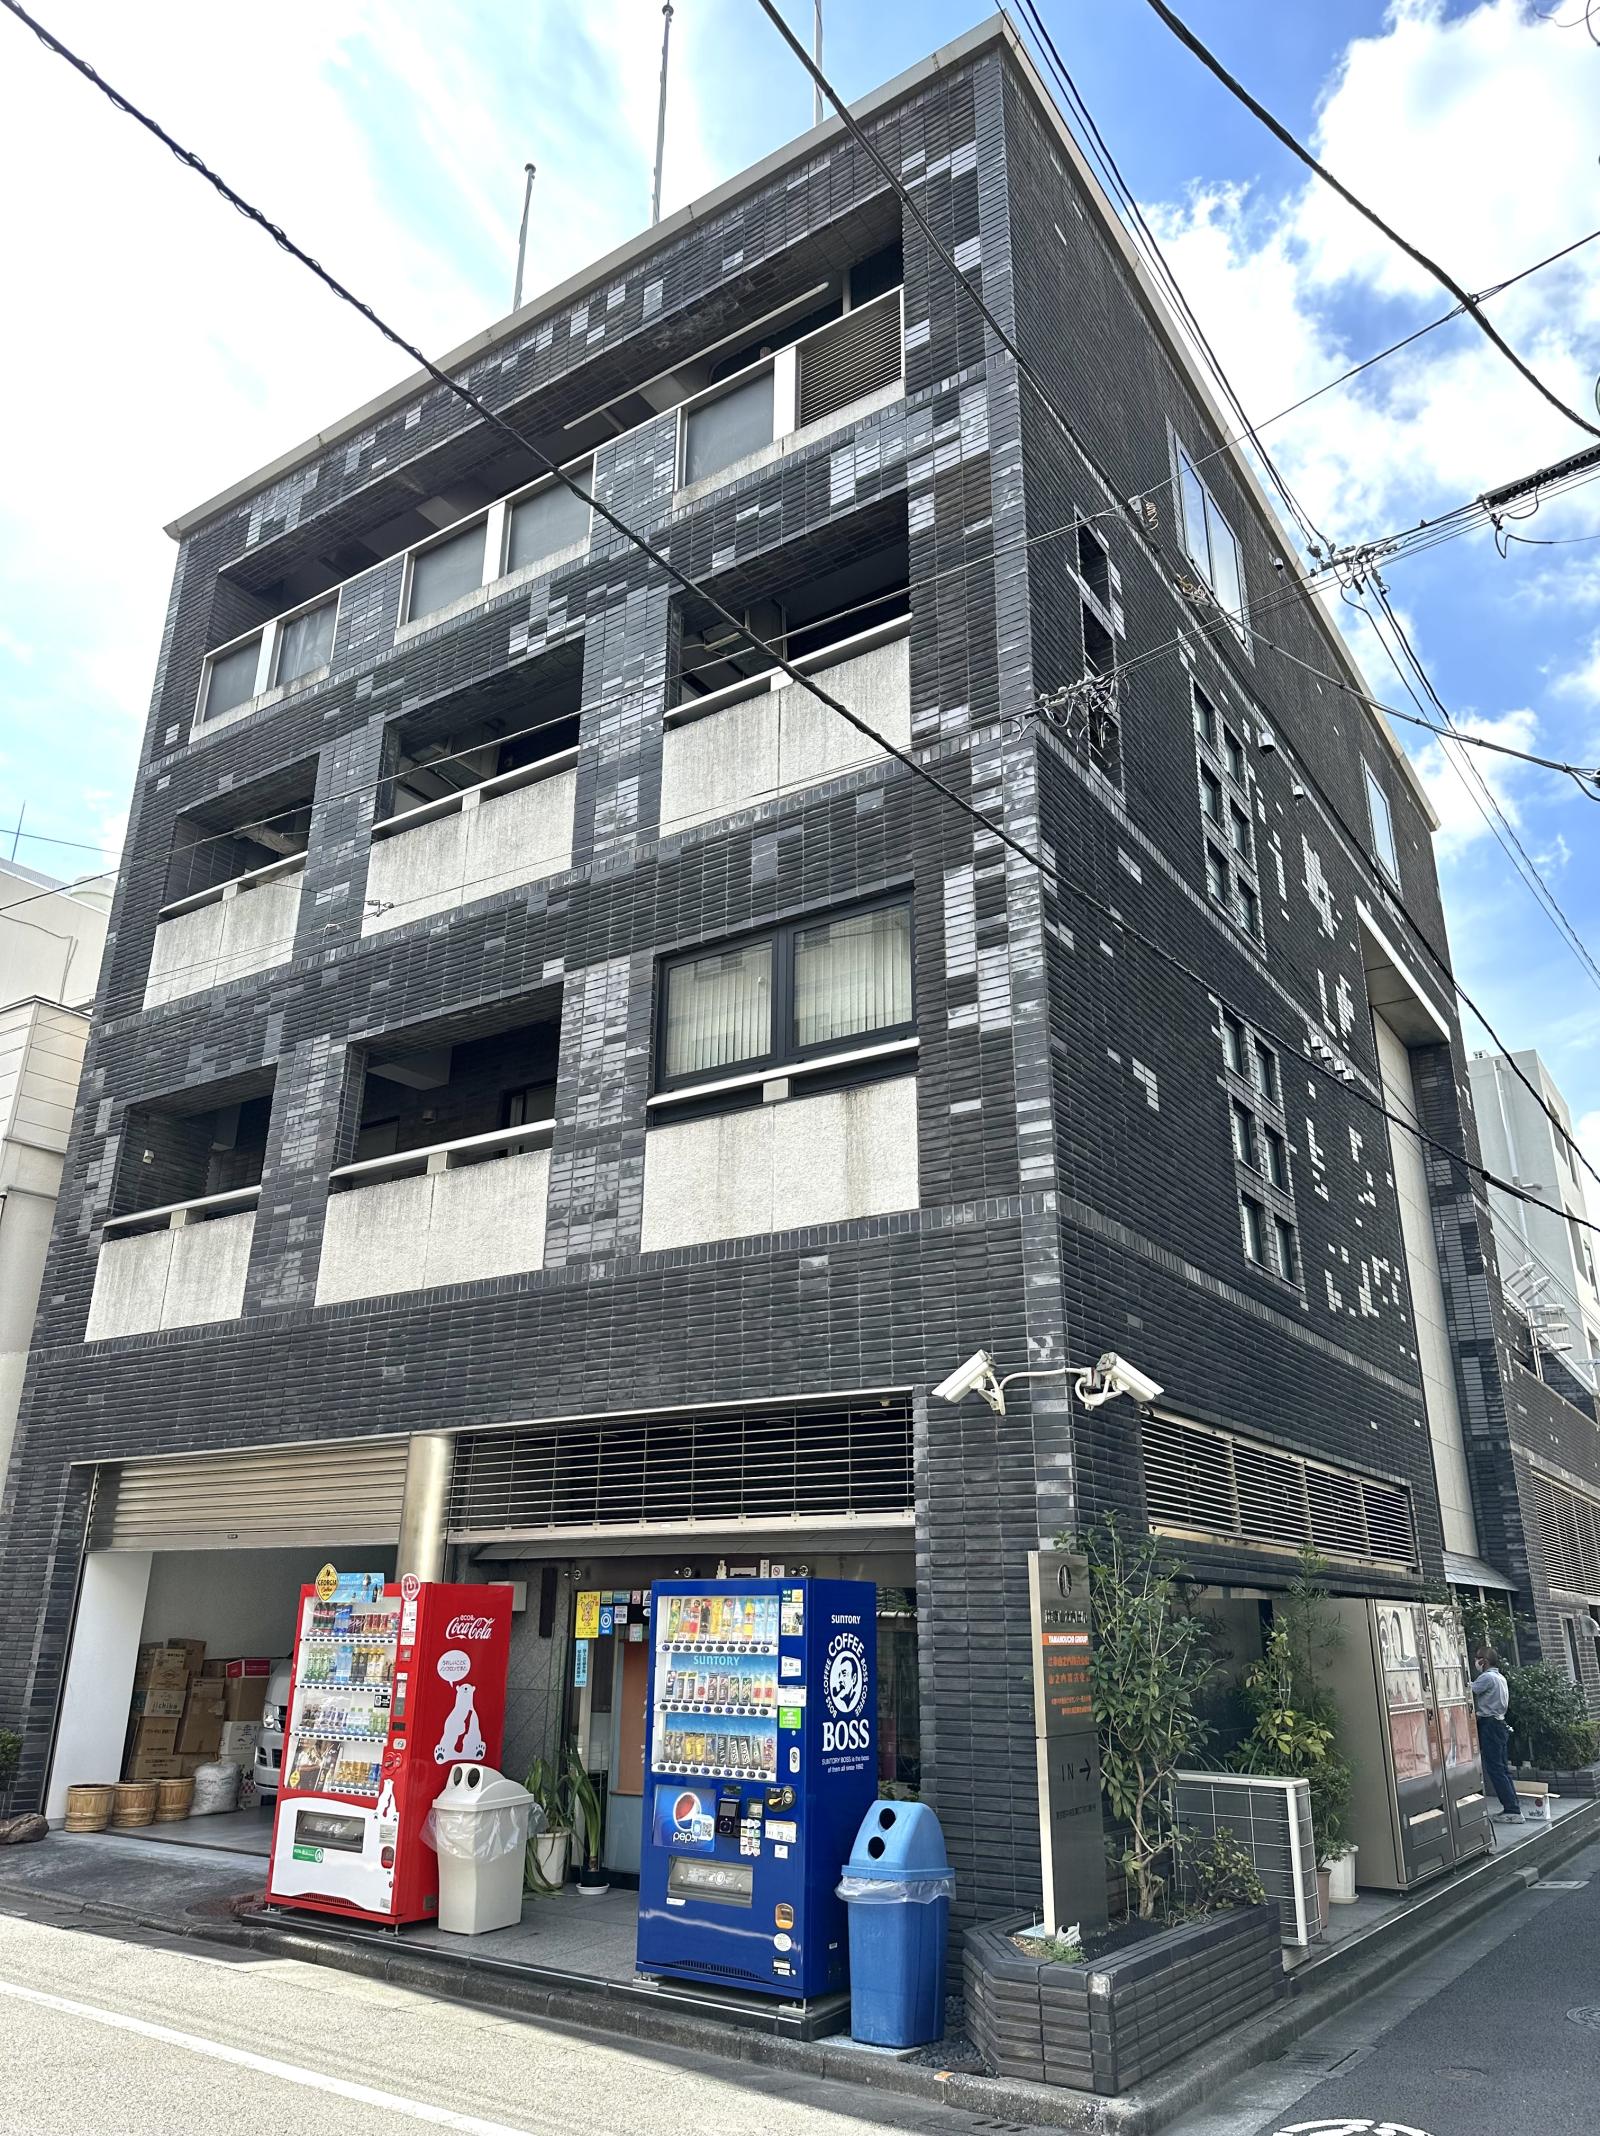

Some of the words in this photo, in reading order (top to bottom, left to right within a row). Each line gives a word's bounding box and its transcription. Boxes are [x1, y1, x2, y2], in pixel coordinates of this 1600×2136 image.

[445, 1616, 496, 1640] Coca-Cola
[831, 1614, 861, 1625] SUNTORY
[828, 1632, 865, 1658] COFFEE
[693, 1655, 740, 1666] SUNTORY
[861, 1658, 869, 1683] BOSS
[823, 1658, 832, 1695] COFFEE
[825, 1696, 838, 1719] BOSS
[855, 1685, 868, 1717] COFFEE
[822, 1719, 870, 1752] BOSS
[821, 1757, 840, 1766] SUNTORY
[840, 1756, 852, 1764] BOSS
[1061, 1762, 1075, 1783] IN
